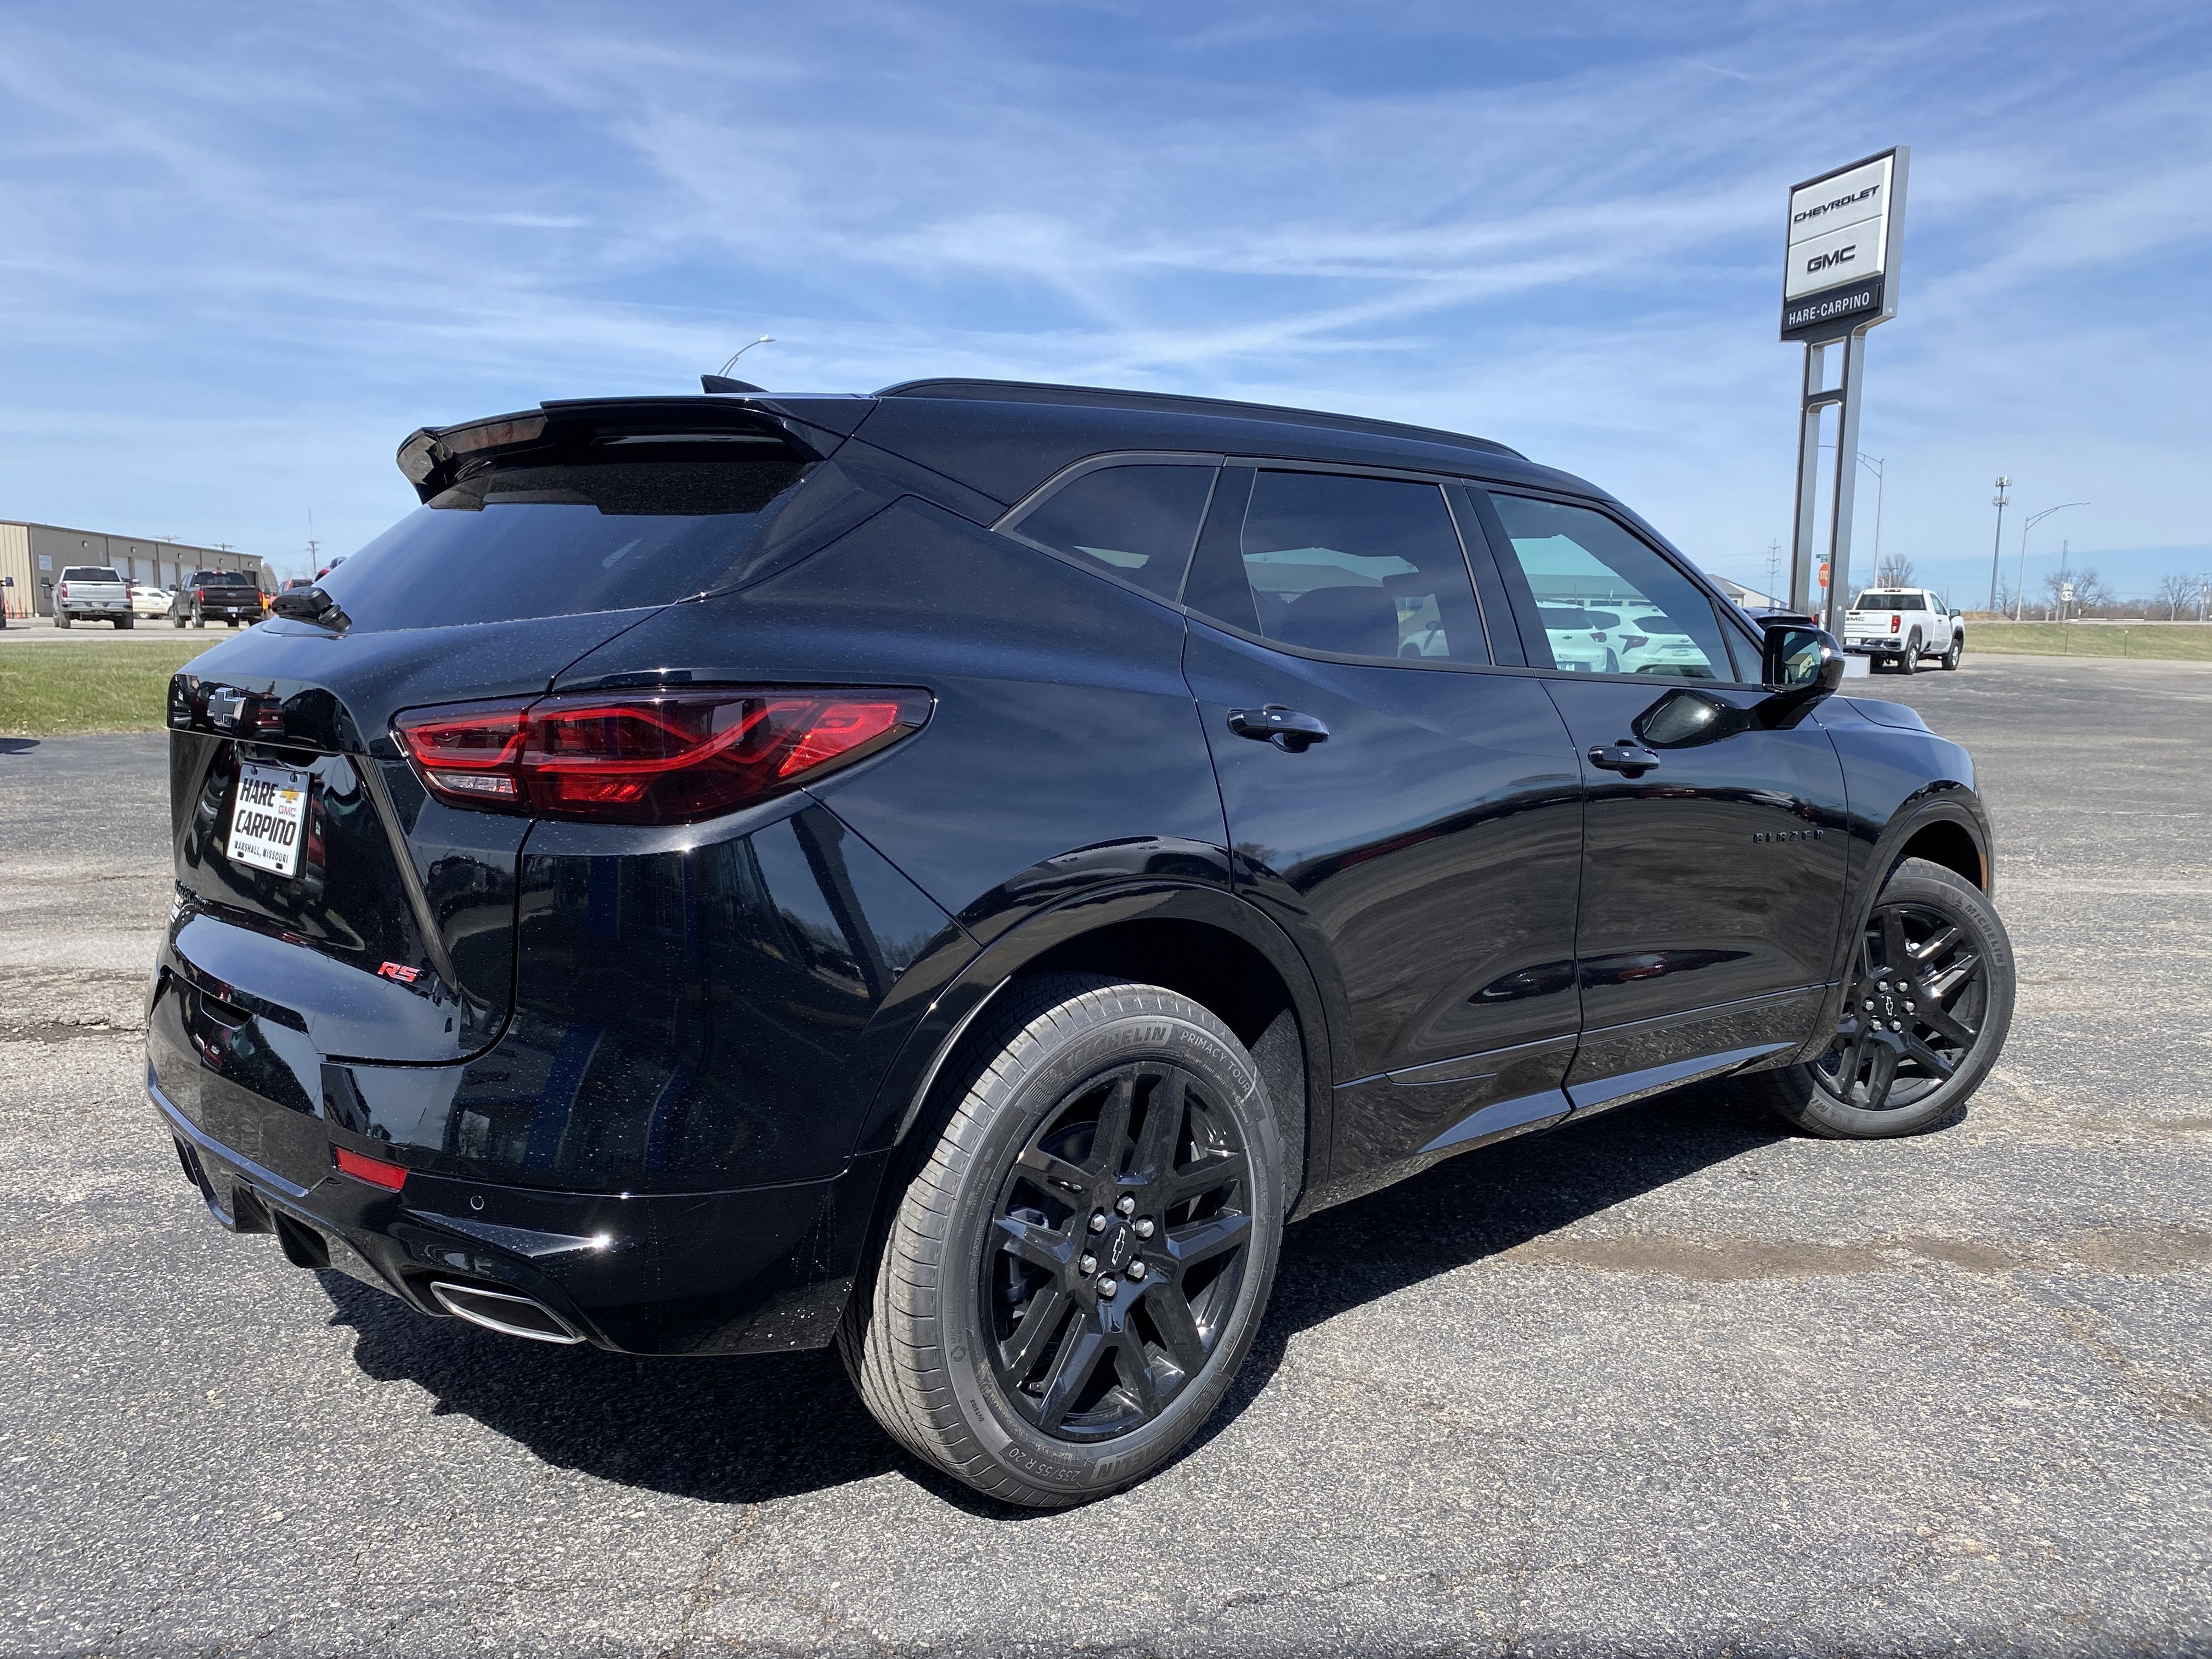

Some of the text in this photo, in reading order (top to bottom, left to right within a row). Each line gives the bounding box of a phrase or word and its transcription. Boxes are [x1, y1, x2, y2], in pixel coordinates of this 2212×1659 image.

[1793, 184, 1880, 224] CHEVROLET
[1807, 244, 1856, 274] GMC
[1788, 292, 1870, 325] HARE-CARPINO
[1819, 570, 1829, 580] STO
[240, 777, 279, 808] HARE
[278, 805, 297, 817] GMC
[235, 809, 297, 847] CARPINO
[1753, 830, 1824, 844] BLAZER
[234, 840, 288, 864] MARSHALL, MISSOURI
[1964, 904, 2005, 963] MICHELIN
[377, 961, 420, 983] RS
[1066, 1026, 1167, 1073] MICHELIN
[1181, 1030, 1227, 1063] PRIMACY
[1228, 1061, 1250, 1093] TOUR
[949, 1304, 957, 1344] MICHELIN
[970, 1399, 984, 1423] OUTSIDE
[1096, 1413, 1190, 1480] MICHELIN
[1008, 1447, 1081, 1482] 235/55 R 20
